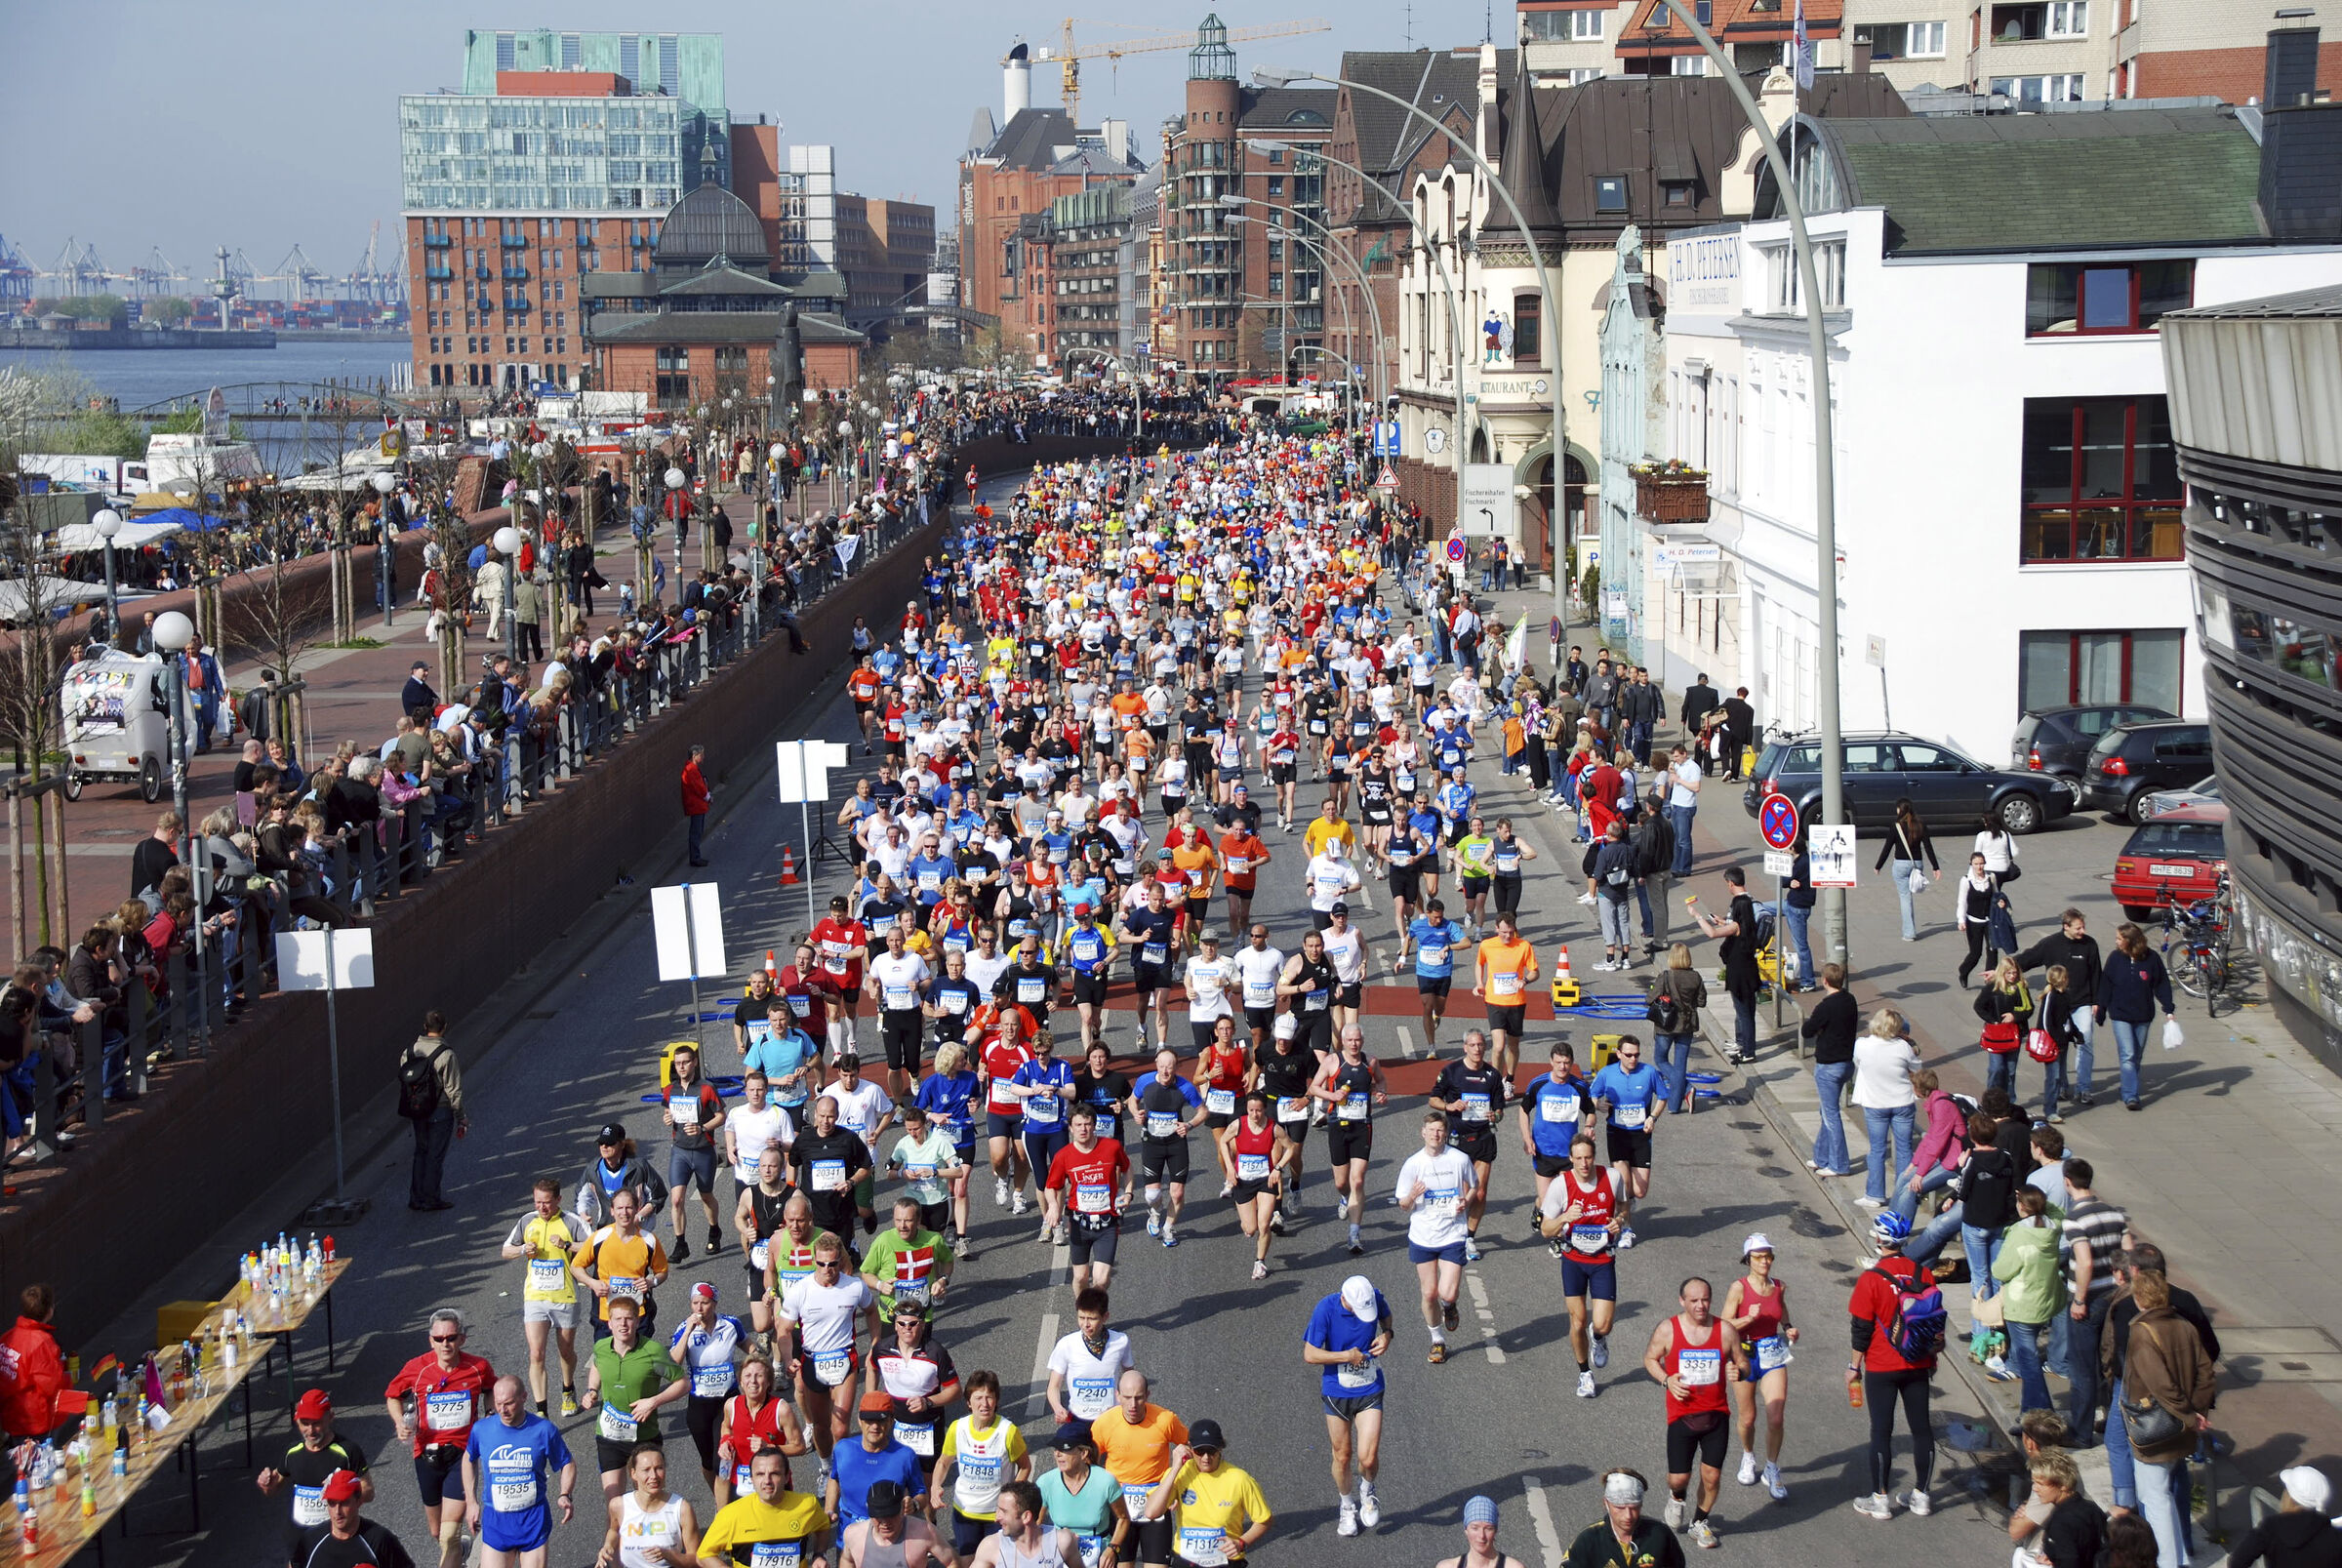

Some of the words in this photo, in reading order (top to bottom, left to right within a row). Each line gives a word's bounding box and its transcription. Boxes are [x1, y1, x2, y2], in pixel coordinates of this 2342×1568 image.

[962, 182, 973, 225] stilwerk
[1697, 236, 1741, 280] PETERSEN
[1081, 1191, 1105, 1200] 5747
[1576, 1232, 1602, 1242] 5569
[534, 1267, 559, 1277] 8430
[819, 1359, 844, 1371] 6045
[1685, 1359, 1713, 1369] 3351
[698, 1372, 728, 1384] F3653
[430, 1392, 467, 1402] CONERGY
[1076, 1387, 1108, 1398] F240
[432, 1402, 464, 1414] 3775
[898, 1429, 927, 1440] 18915
[963, 1465, 994, 1476] F1848
[495, 1473, 532, 1483] CONERGY
[497, 1483, 530, 1495] 19535
[627, 1523, 666, 1537] NXP
[757, 1545, 797, 1554] CONERGY
[1186, 1539, 1219, 1550] F1312
[759, 1555, 793, 1567] 17916
